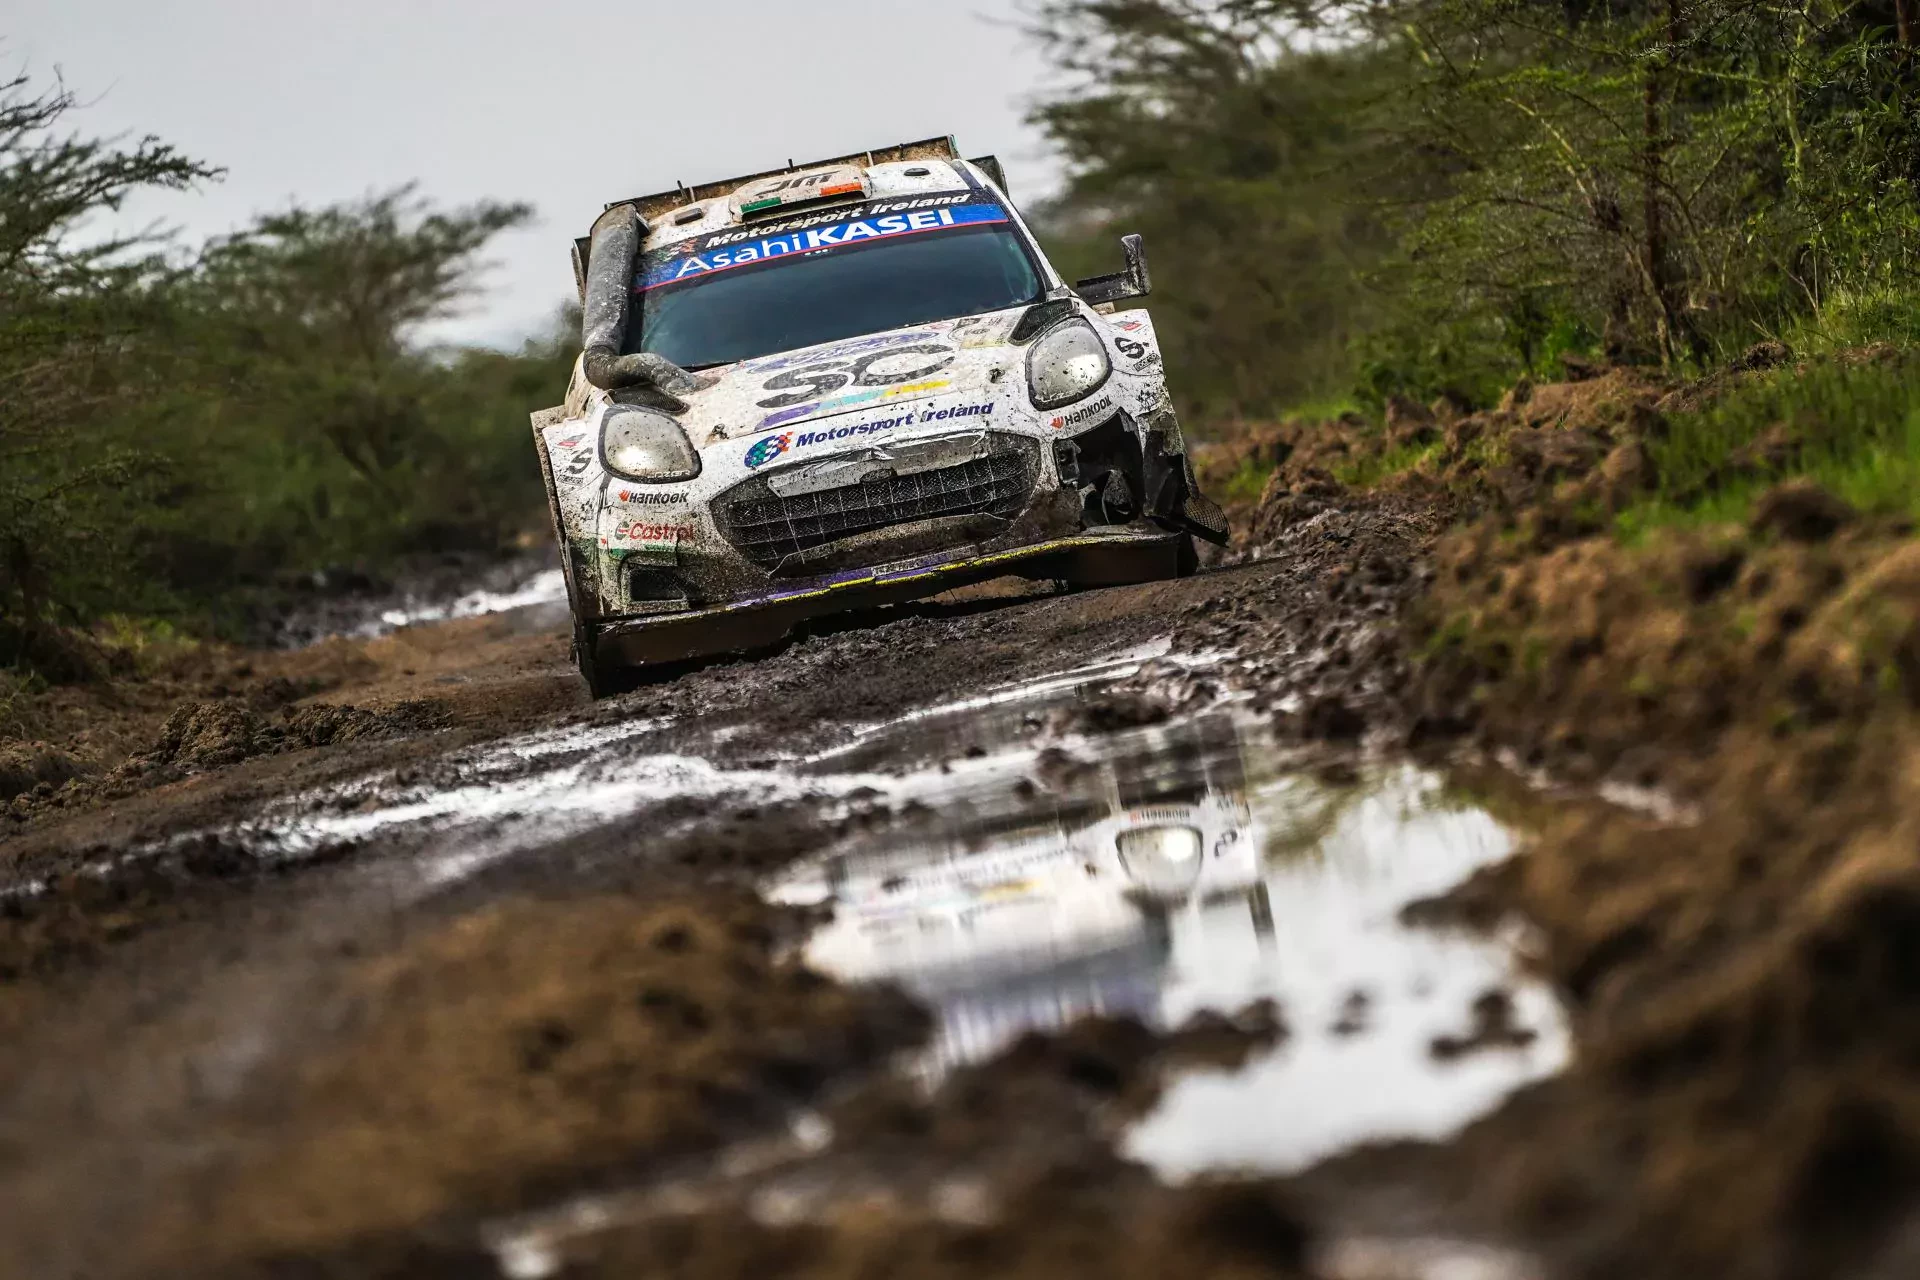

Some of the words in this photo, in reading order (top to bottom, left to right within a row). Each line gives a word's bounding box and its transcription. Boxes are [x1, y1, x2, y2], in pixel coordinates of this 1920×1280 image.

[675, 208, 955, 278] AsahiKASEI
[705, 206, 863, 249] Motorsport
[870, 193, 970, 215] Ireland
[795, 409, 914, 448] Motorsport
[919, 402, 995, 423] Ireland
[628, 522, 695, 541] Castrol
